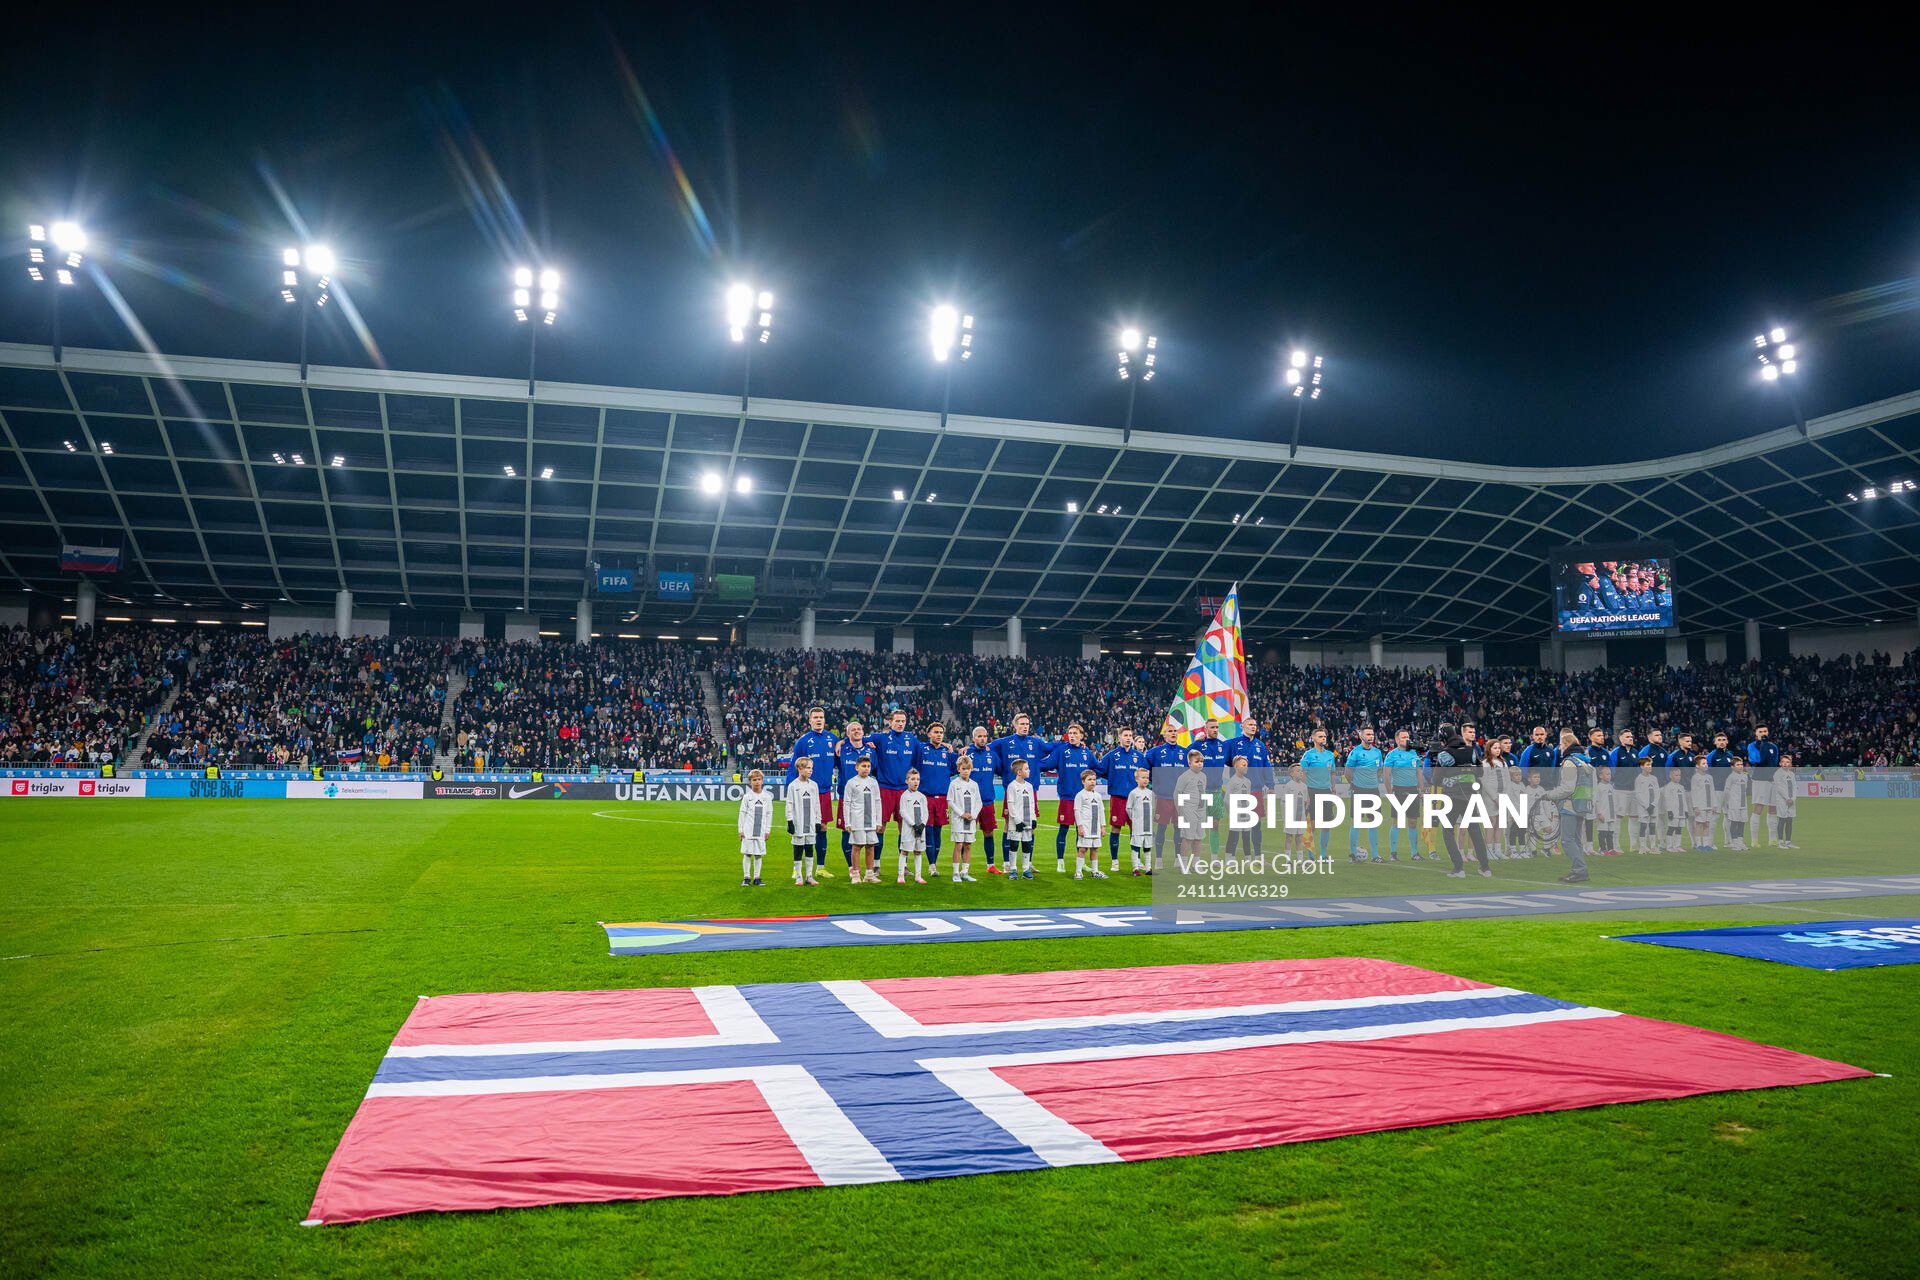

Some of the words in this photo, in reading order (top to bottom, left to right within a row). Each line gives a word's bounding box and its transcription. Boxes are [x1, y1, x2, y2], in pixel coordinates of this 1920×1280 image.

[602, 576, 628, 586] FIFA
[659, 581, 690, 592] UEFA
[1591, 615, 1627, 623] NATIONS
[1628, 613, 1660, 621] LEAGUE
[31, 783, 65, 794] triglav
[97, 783, 131, 794] triglav
[615, 784, 672, 801] UEFA
[675, 784, 775, 801] NATIOS
[1820, 784, 1844, 795] triglav
[830, 909, 1287, 936] UEFA
[1259, 883, 1863, 919] NATIONS
